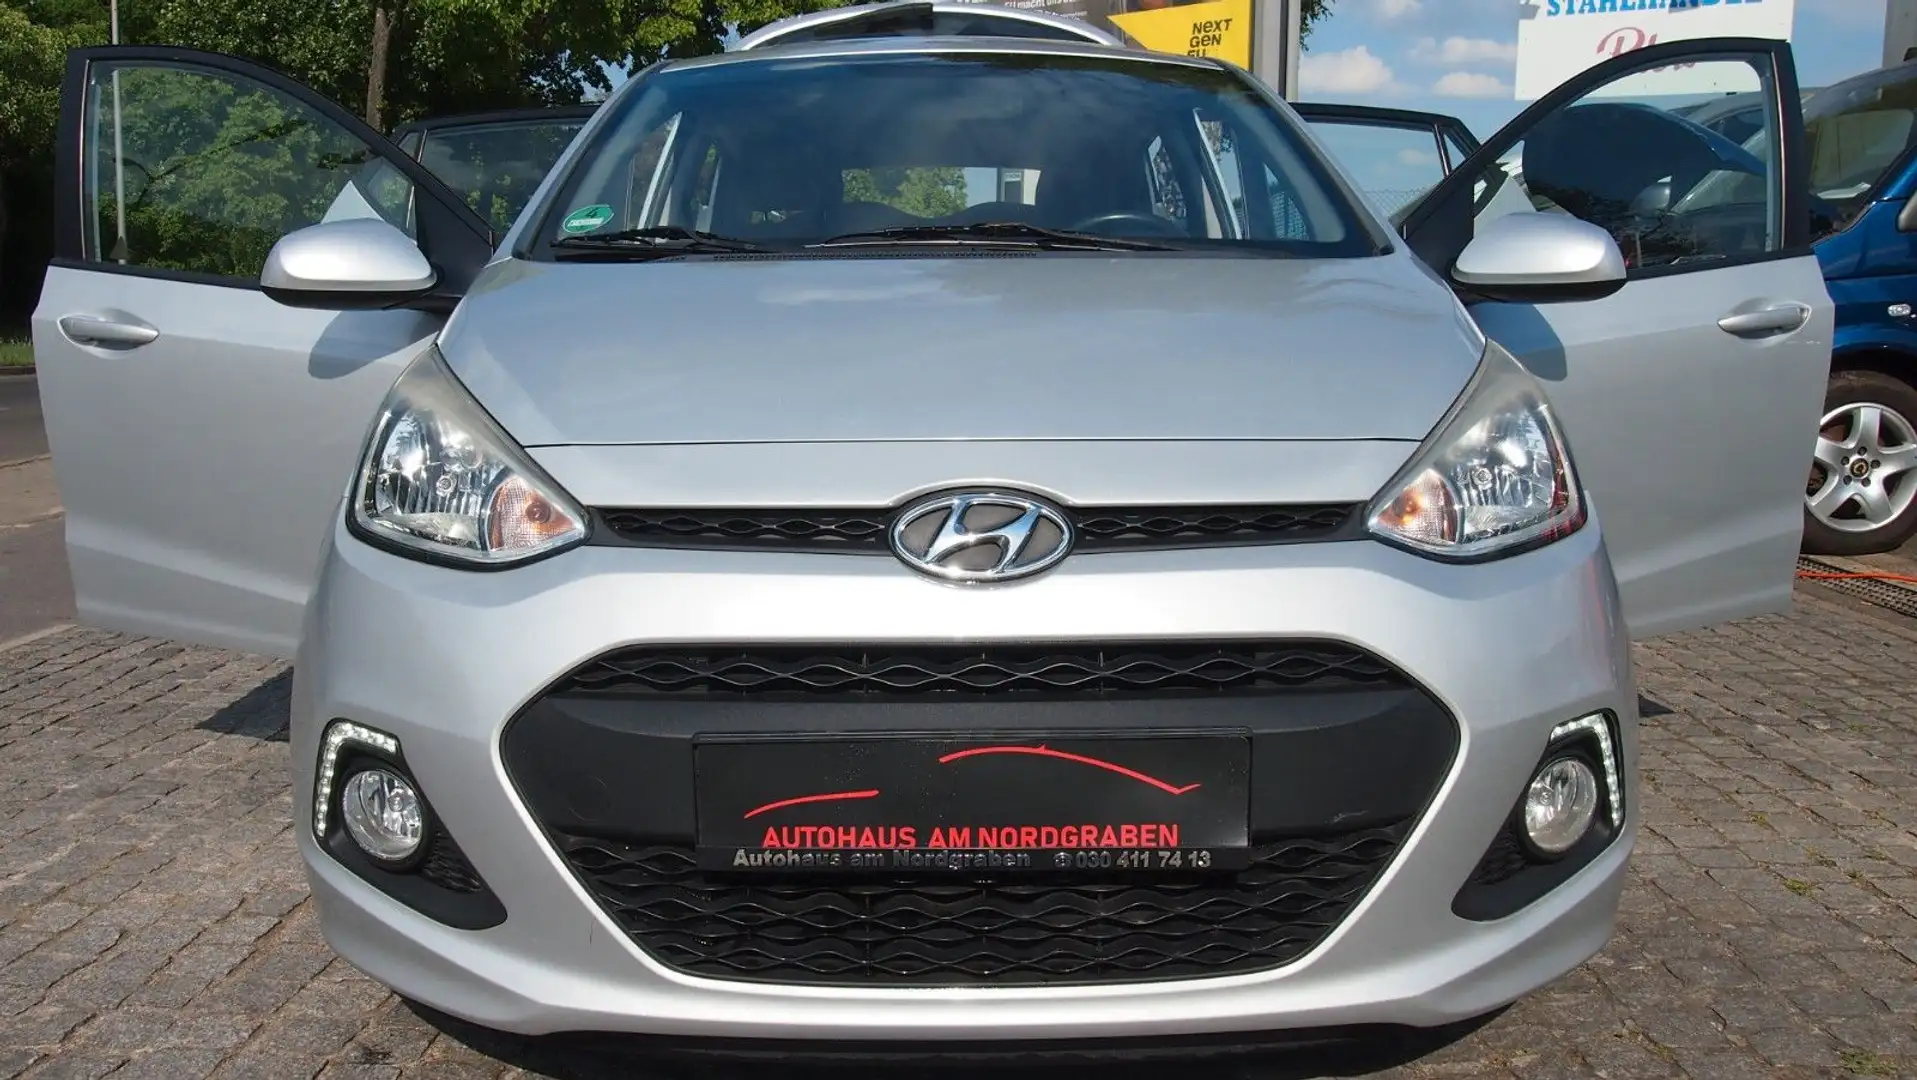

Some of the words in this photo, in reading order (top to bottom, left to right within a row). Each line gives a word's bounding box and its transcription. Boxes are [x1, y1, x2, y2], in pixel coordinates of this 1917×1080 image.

[762, 826, 917, 849] AUTOHAUS
[928, 826, 970, 849] AM
[978, 824, 1178, 849] NORDGRABEN
[733, 849, 842, 867] Autohaus
[850, 852, 885, 867] am
[893, 849, 1031, 870] Nordgraben
[1075, 850, 1112, 868] 030
[1116, 850, 1150, 868] 411
[1158, 850, 1183, 868] 74
[1188, 850, 1211, 868] 13
